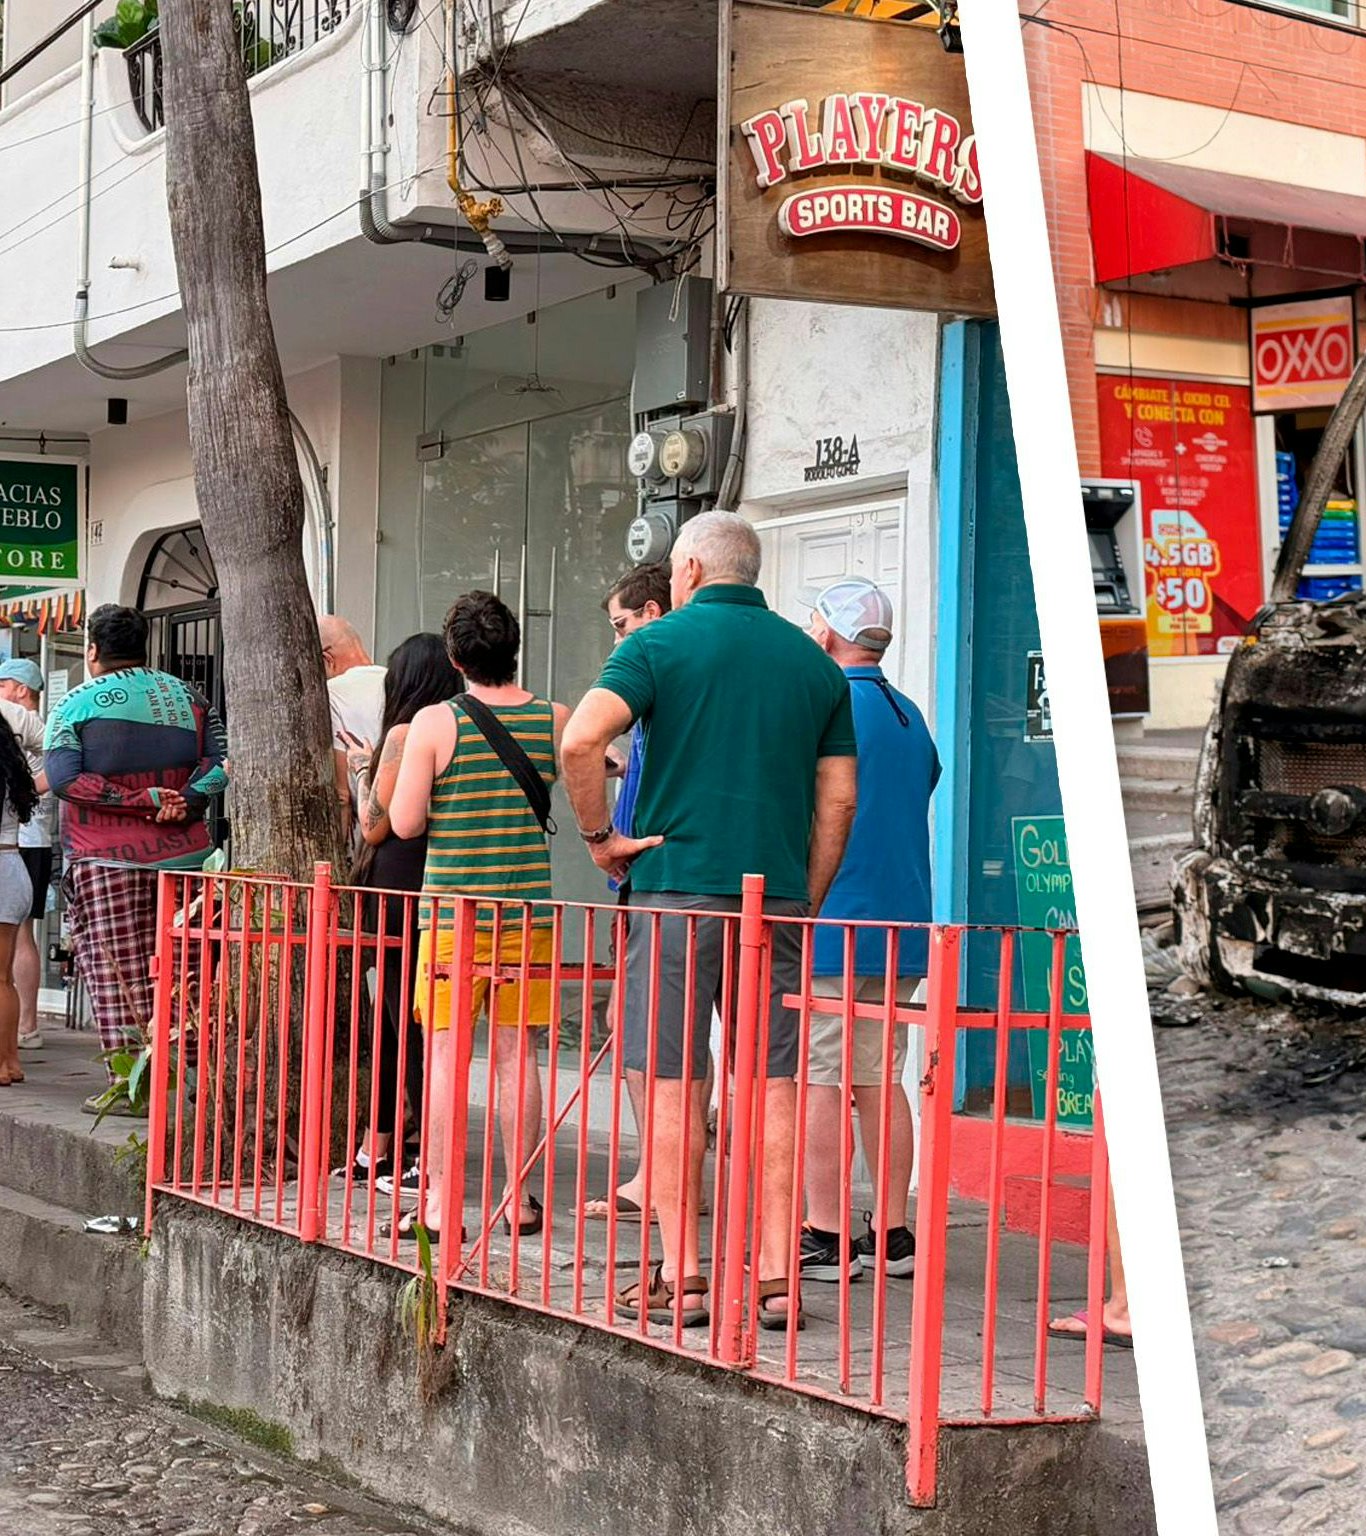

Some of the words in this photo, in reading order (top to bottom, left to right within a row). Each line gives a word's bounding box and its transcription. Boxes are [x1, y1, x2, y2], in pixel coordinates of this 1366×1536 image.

[741, 92, 983, 204] PLAYERS
[798, 193, 893, 228] SPORTS
[901, 199, 950, 241] BAR
[1257, 325, 1348, 385] OXXO
[1137, 403, 1196, 423] CONECTA
[1199, 408, 1225, 426] CON
[816, 433, 860, 467] 138-A
[0, 507, 62, 530] EBLO
[0, 549, 65, 570] ORE
[1144, 541, 1214, 567] 4.5GB
[1157, 577, 1205, 610] $50
[1026, 872, 1072, 893] OLYMP
